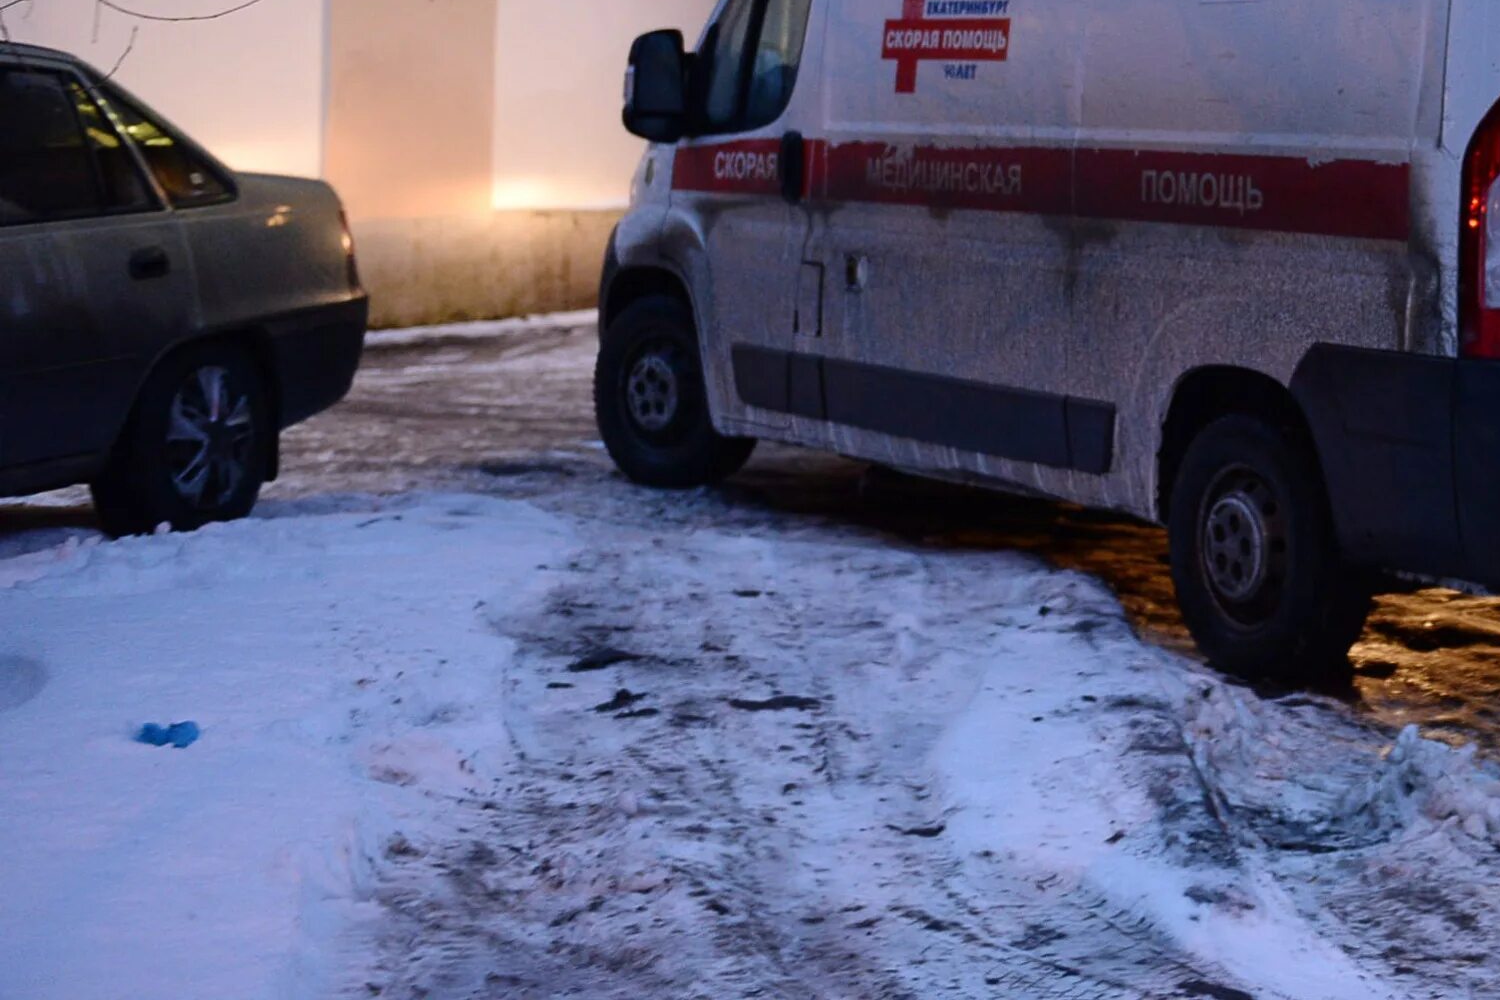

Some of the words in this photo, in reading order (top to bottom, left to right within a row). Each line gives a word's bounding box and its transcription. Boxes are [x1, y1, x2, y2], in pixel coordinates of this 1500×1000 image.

[927, 0, 1009, 15] ЕКАТЕРИНБУРГ
[886, 30, 940, 50] СКОРАЯ
[942, 30, 1006, 53] ПОМОЩЬ
[714, 151, 778, 181] СКОРАЯ
[866, 156, 1021, 194] МЕДИЦИНСКАЯ
[1141, 171, 1264, 216] ПОМОЩЬ
